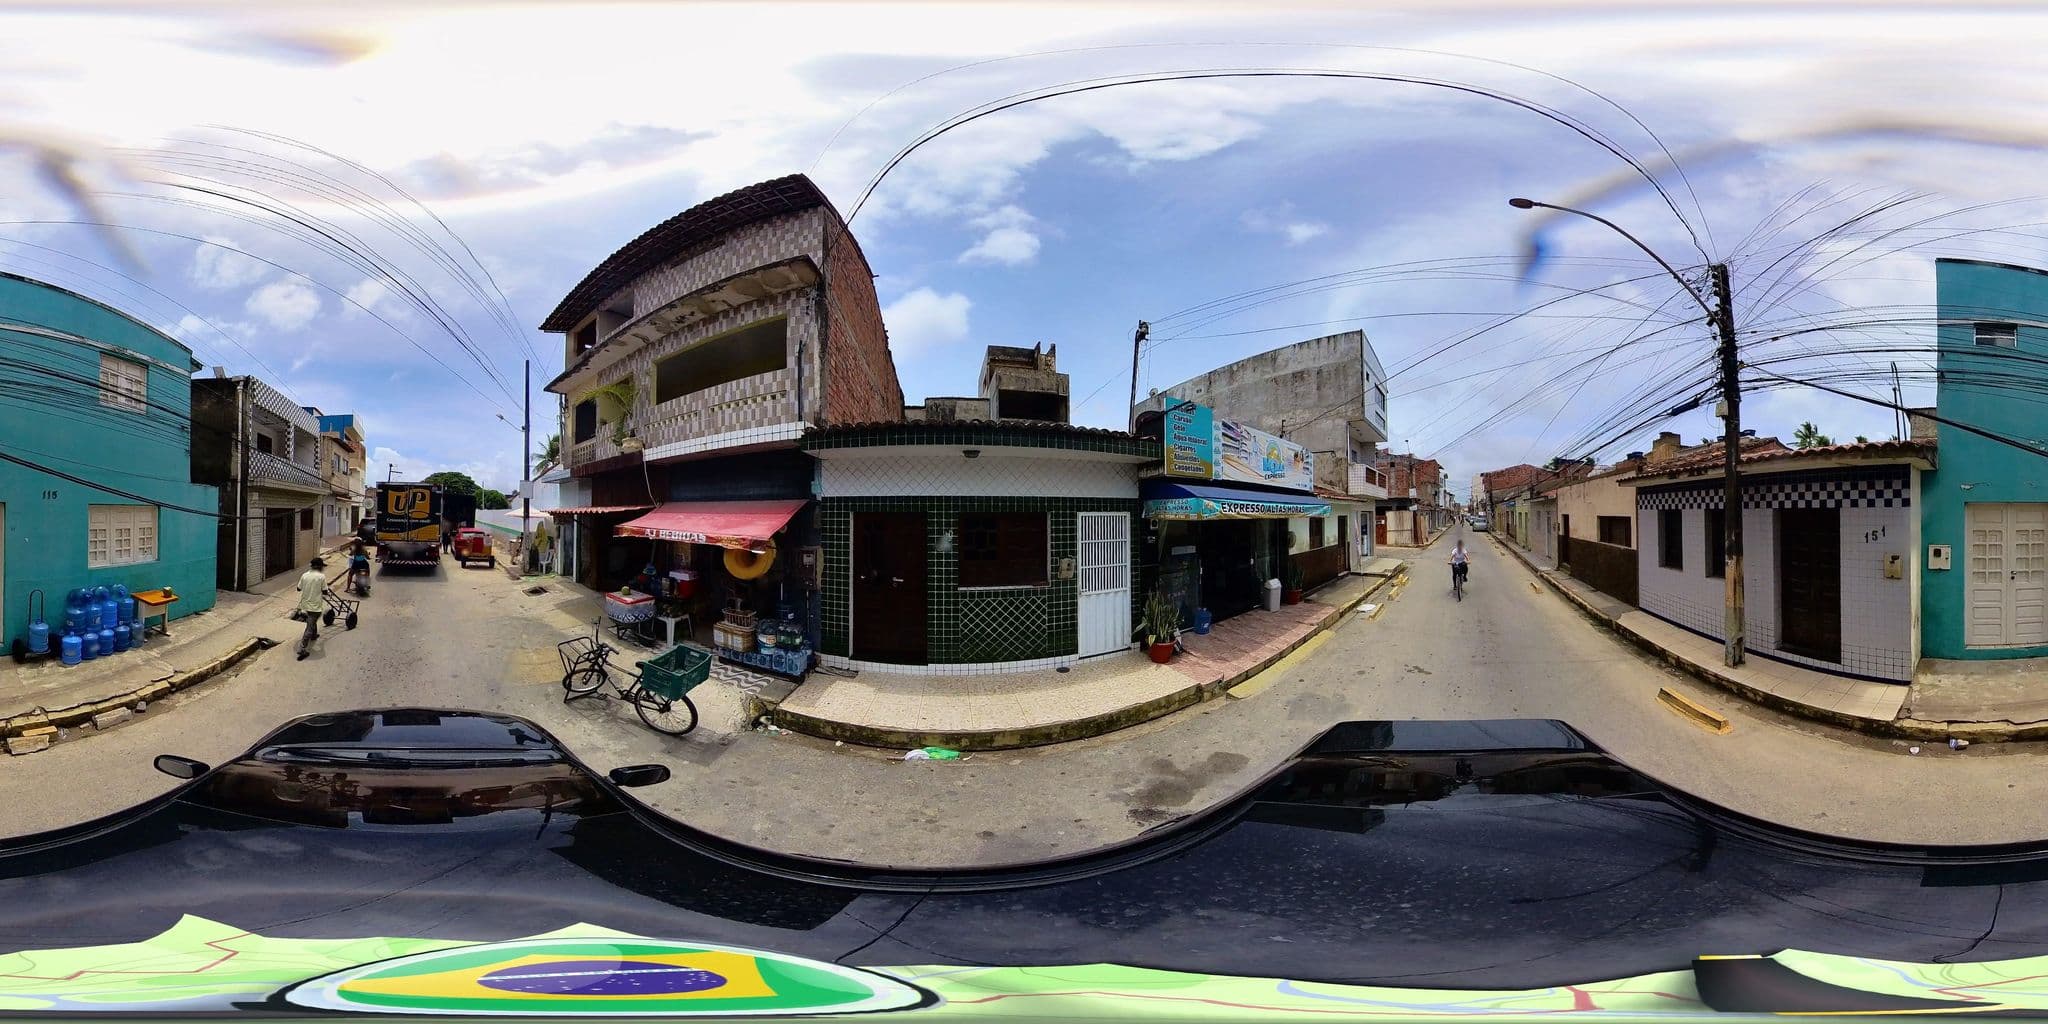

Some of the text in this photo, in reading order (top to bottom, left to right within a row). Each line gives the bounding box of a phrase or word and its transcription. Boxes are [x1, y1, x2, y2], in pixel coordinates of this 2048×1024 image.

[1221, 502, 1265, 513] EXPRESSO
[1266, 505, 1286, 513] ALTAS
[659, 530, 706, 543] BEBIDAS
[1864, 525, 1886, 543] 151
